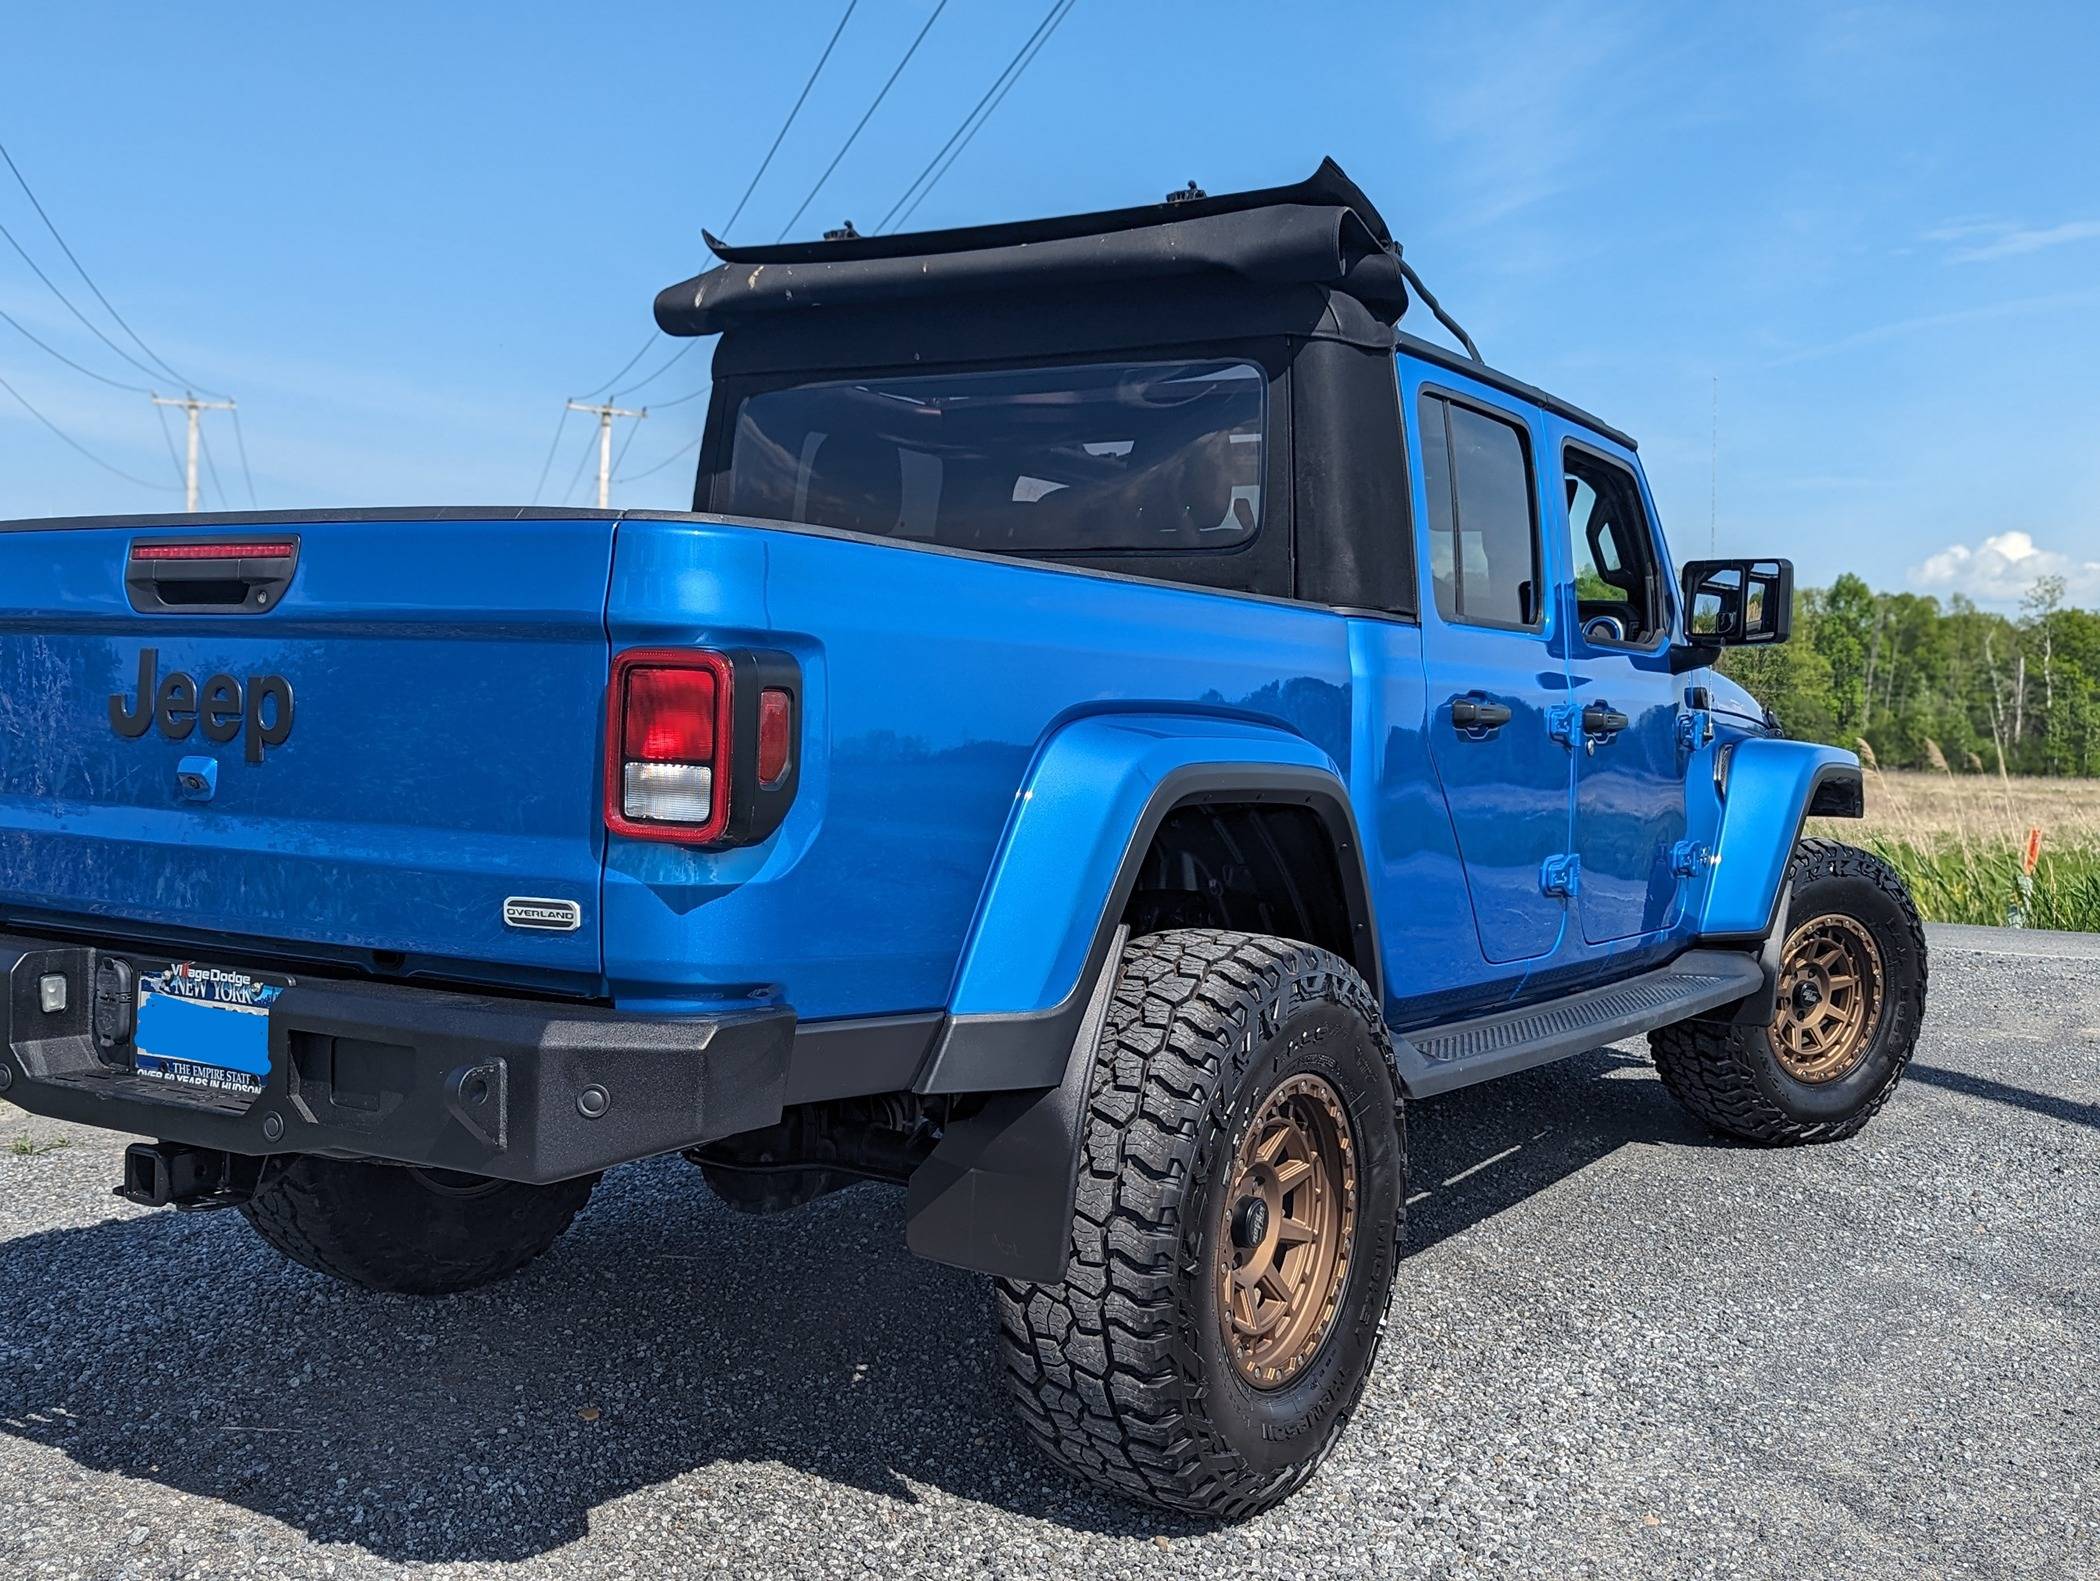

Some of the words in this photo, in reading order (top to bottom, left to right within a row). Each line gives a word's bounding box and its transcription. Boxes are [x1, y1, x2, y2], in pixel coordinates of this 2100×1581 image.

[108, 647, 294, 763] Jeep
[507, 908, 574, 920] OVERLAND
[175, 976, 207, 998] NEW
[214, 981, 253, 1004] YORK
[173, 1062, 191, 1075] THE
[193, 1065, 225, 1081] EMPIRE
